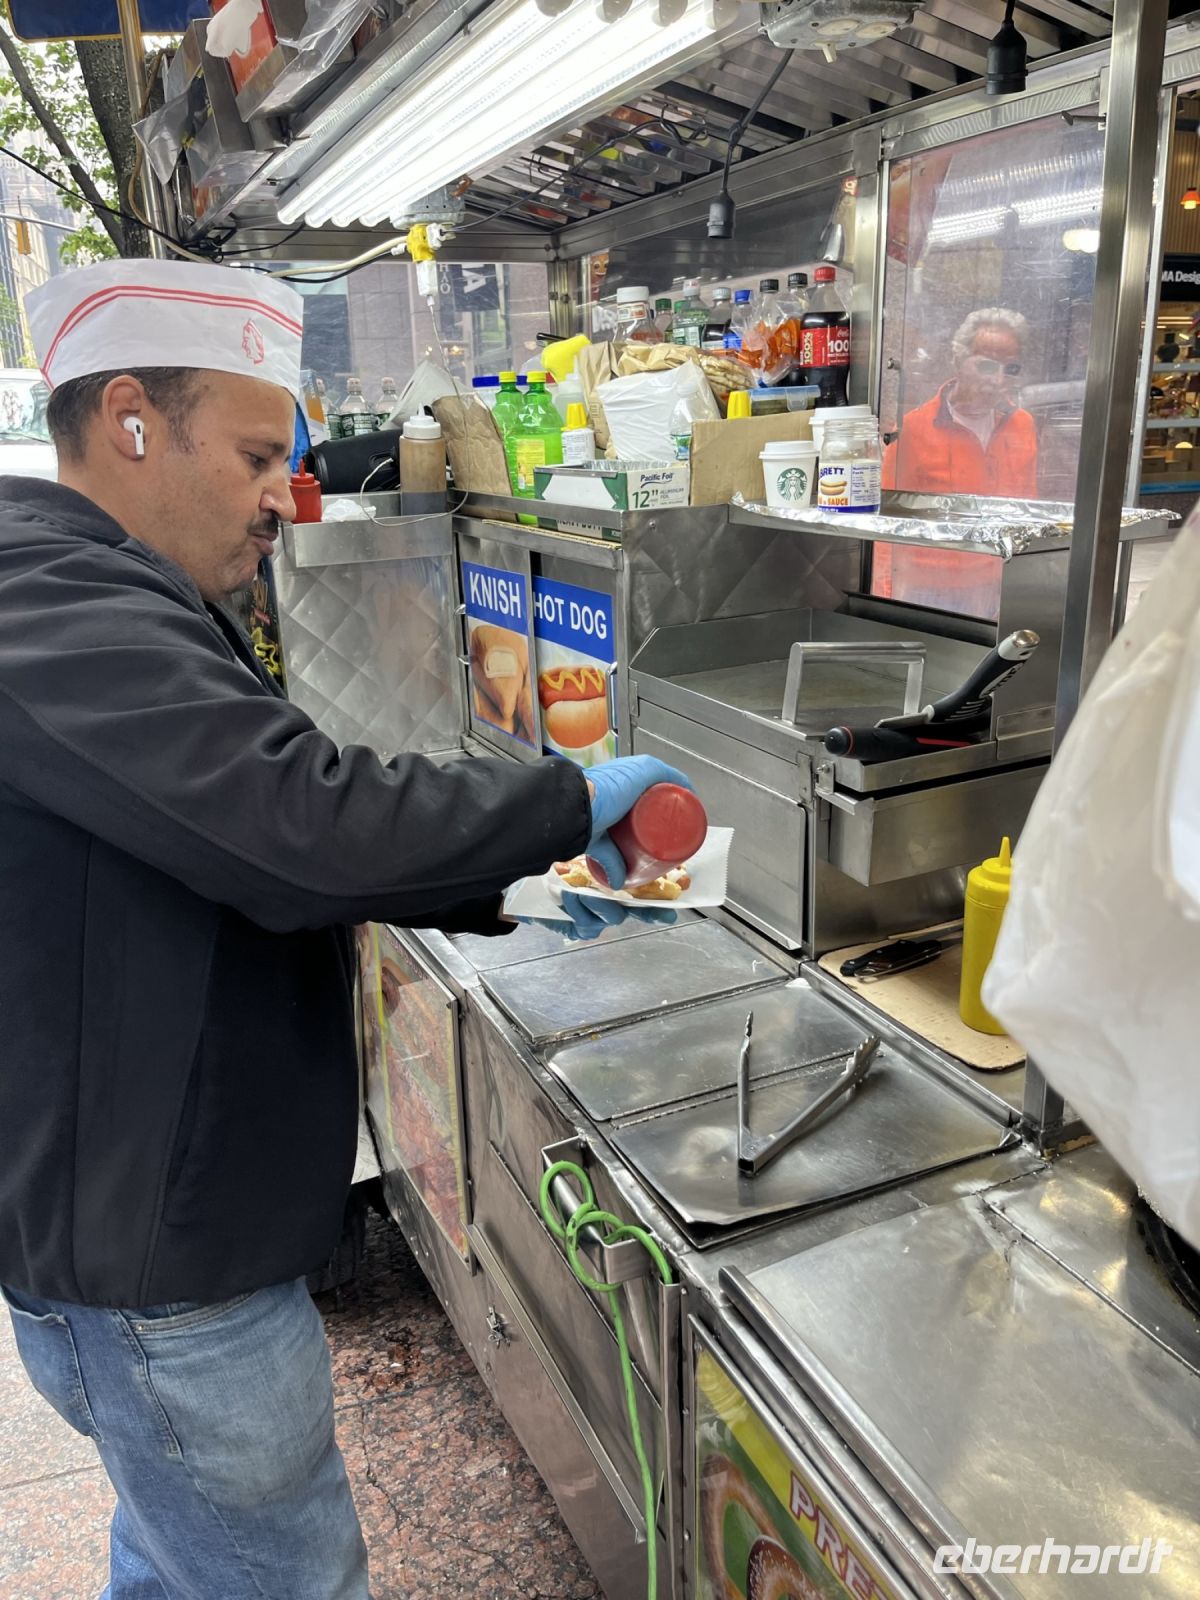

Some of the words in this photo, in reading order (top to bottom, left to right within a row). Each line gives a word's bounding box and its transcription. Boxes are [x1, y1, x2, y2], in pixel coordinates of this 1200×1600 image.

[640, 474, 660, 482] Pacific
[662, 472, 674, 480] Foil
[828, 498, 848, 506] SAUCE
[469, 571, 521, 618] KNISH
[533, 591, 565, 625] HOT
[570, 602, 607, 640] DOG
[789, 1470, 890, 1600] PRE
